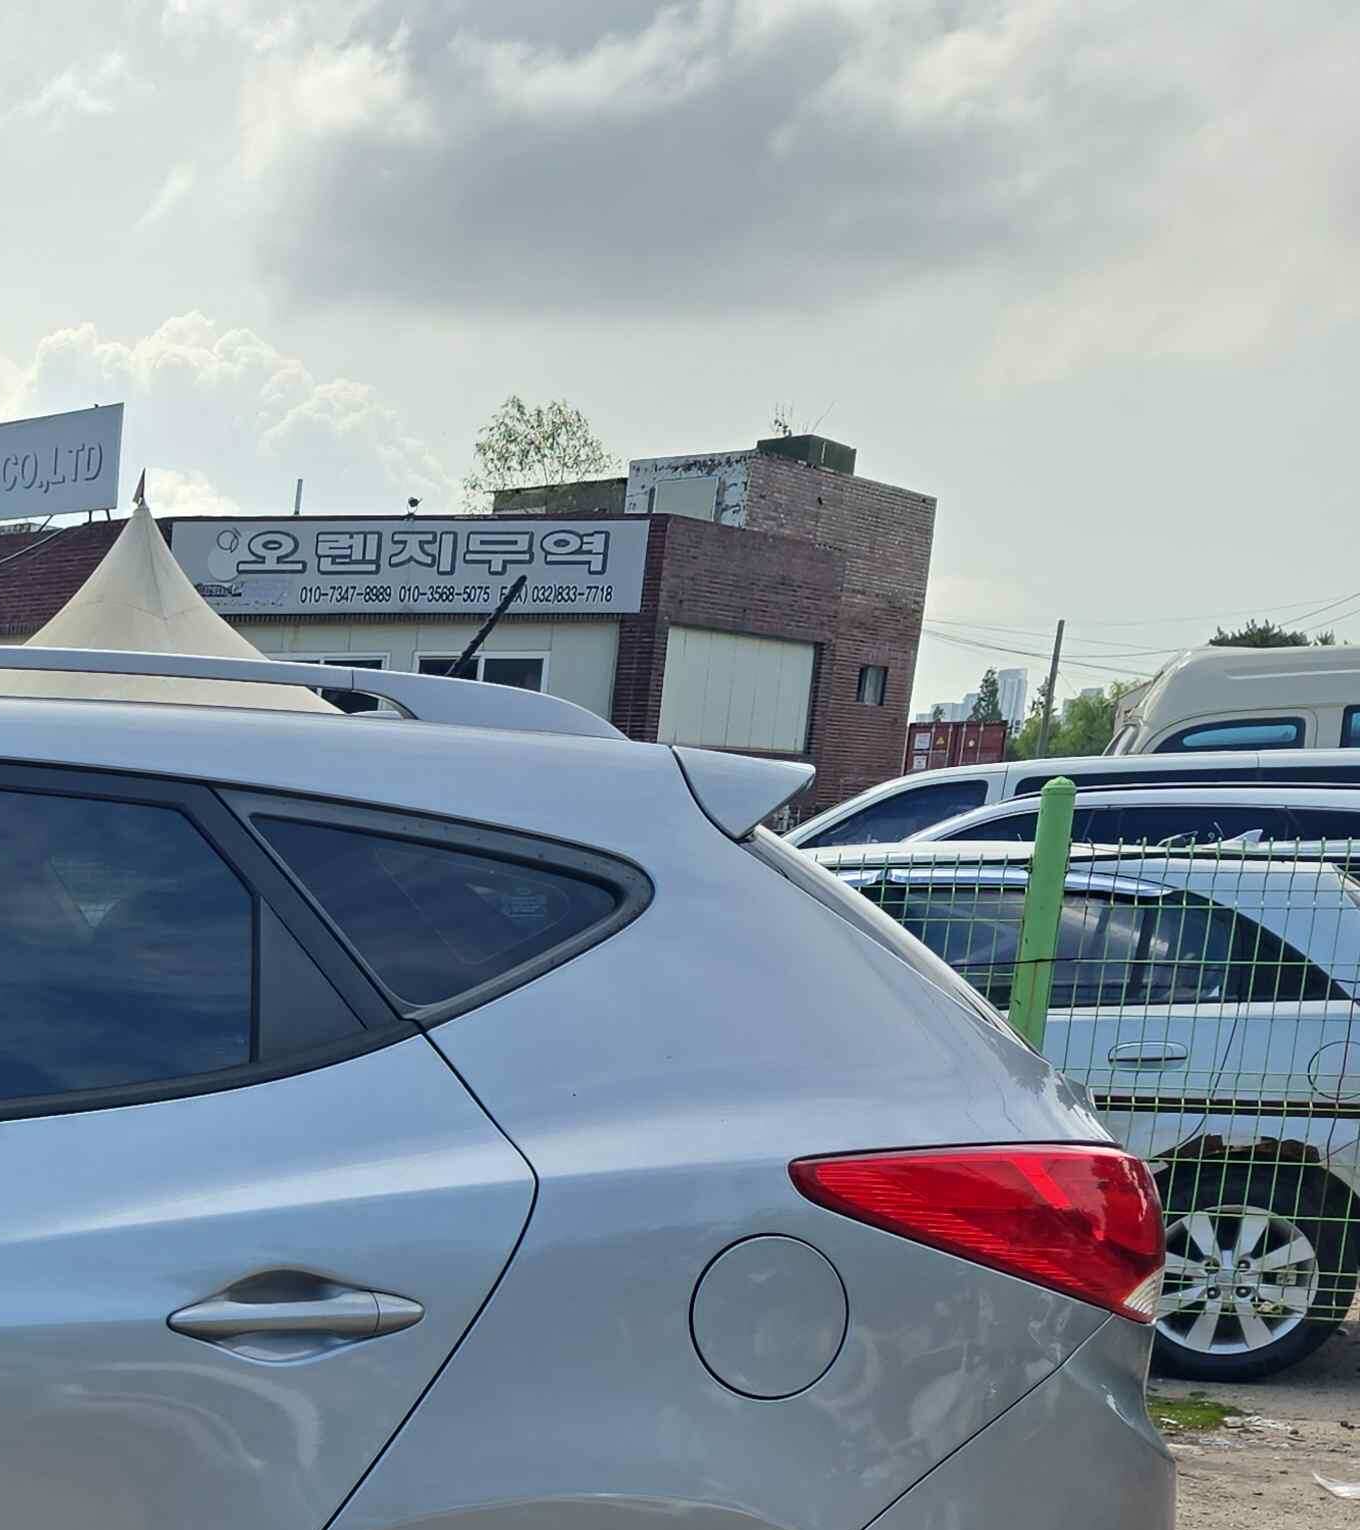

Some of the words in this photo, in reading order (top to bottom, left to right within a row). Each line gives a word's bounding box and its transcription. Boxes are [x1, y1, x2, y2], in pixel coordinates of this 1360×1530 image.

[236, 530, 610, 575] 오렌지무역
[299, 586, 392, 603] 010-7347-8989
[398, 585, 490, 602] 010-3568-5075
